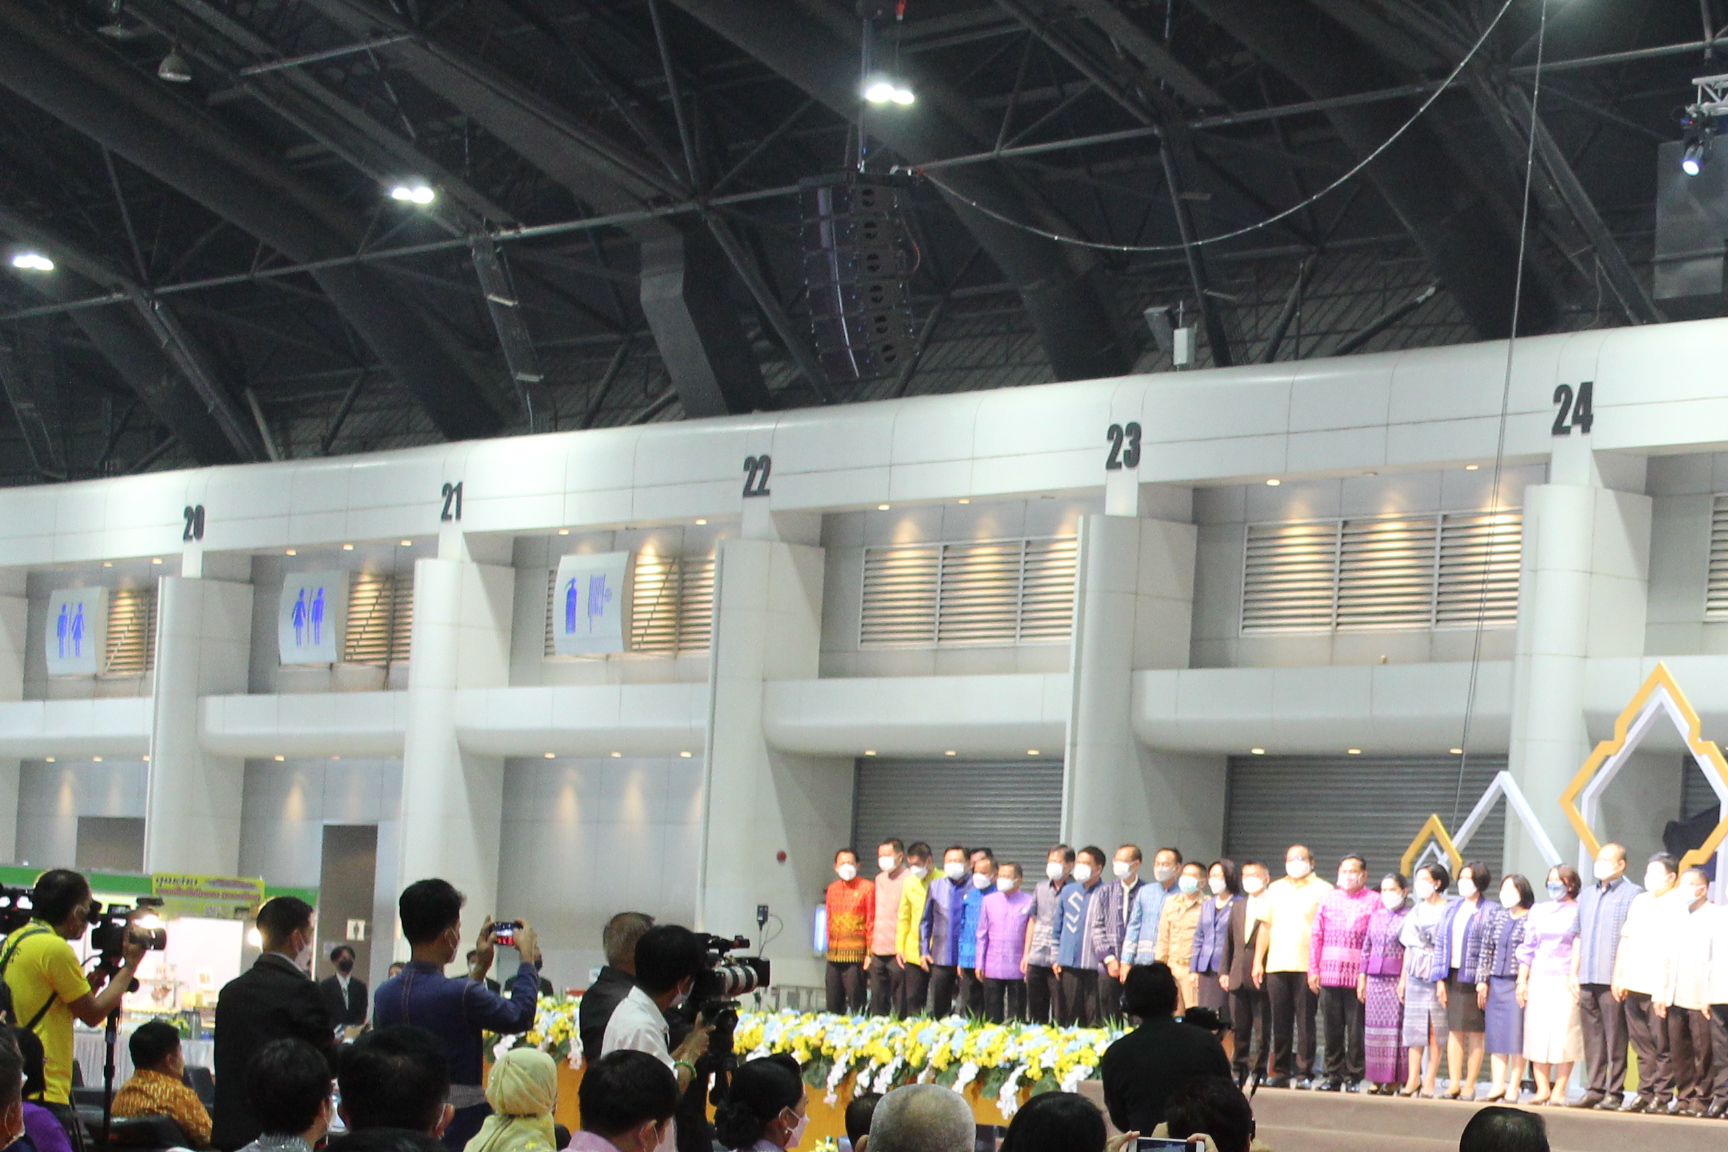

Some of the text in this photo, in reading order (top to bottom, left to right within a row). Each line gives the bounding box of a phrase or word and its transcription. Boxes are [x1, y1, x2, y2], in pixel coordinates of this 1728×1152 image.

[1551, 381, 1594, 436] 24
[1106, 422, 1142, 470] 23
[742, 454, 772, 498] 22
[183, 504, 205, 541] 20
[441, 482, 462, 521] 21
